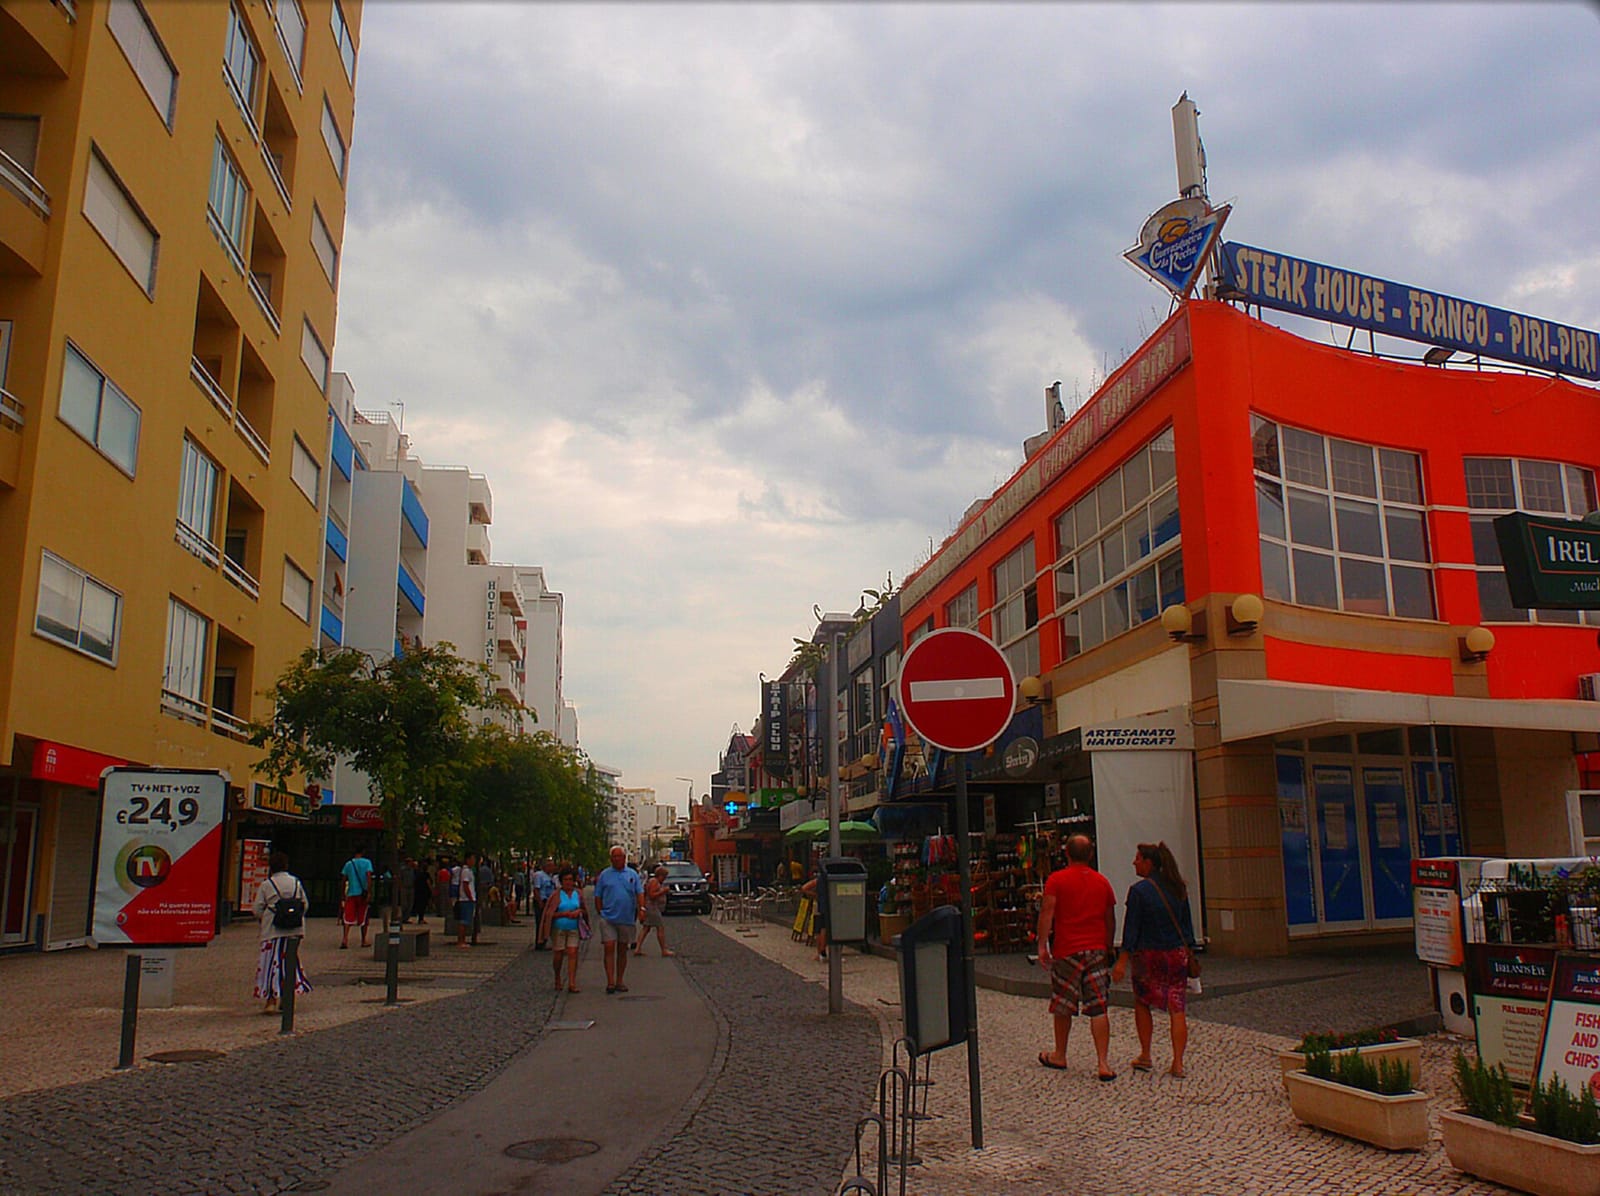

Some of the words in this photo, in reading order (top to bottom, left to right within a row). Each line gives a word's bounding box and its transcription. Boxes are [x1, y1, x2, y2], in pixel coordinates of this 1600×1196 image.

[1236, 248, 1307, 309] STEAK
[1314, 266, 1385, 323] HOUSE
[1409, 290, 1489, 347] FRANGO
[1508, 314, 1597, 373] PIRI-PIRI
[487, 580, 496, 631] HOTEL
[770, 682, 781, 718] STRIP
[770, 722, 781, 752] CLUB
[1085, 728, 1176, 738] ARTESANATO
[1086, 737, 1177, 747] HANDICRAFT
[131, 784, 200, 794] TV+NET+VOZ
[117, 797, 198, 832] €24,9
[134, 856, 163, 878] TV
[1575, 1012, 1600, 1030] FISH
[1571, 1031, 1598, 1049] AND
[1564, 1050, 1600, 1070] CHIPS
